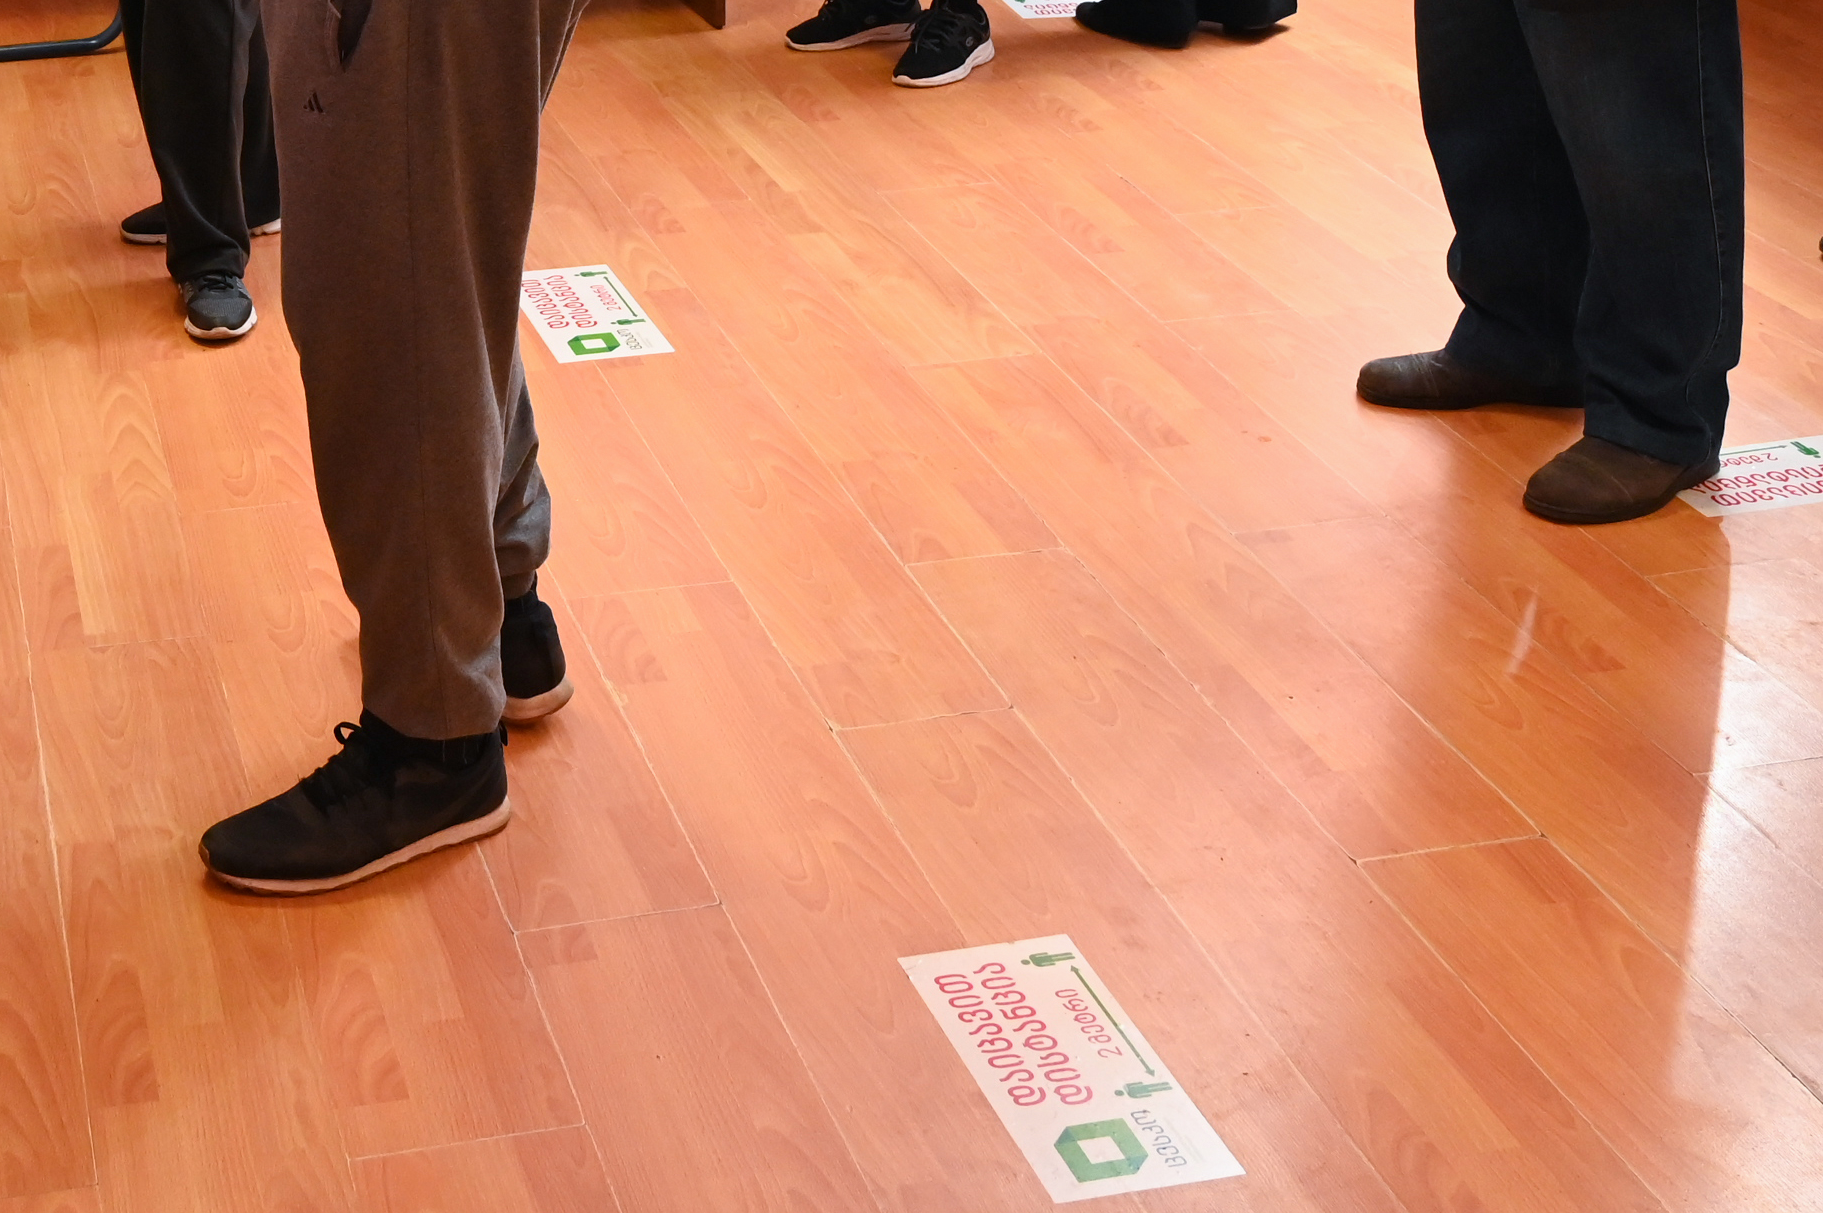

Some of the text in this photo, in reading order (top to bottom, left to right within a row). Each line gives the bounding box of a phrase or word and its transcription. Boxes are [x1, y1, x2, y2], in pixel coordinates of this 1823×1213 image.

[543, 275, 598, 329] დისტანცია
[933, 974, 1047, 1107] დაიცავით
[973, 962, 1094, 1106] დისტანცია
[1054, 988, 1123, 1059] 2 მეტრი
[1130, 1108, 1188, 1169] ცესკო
